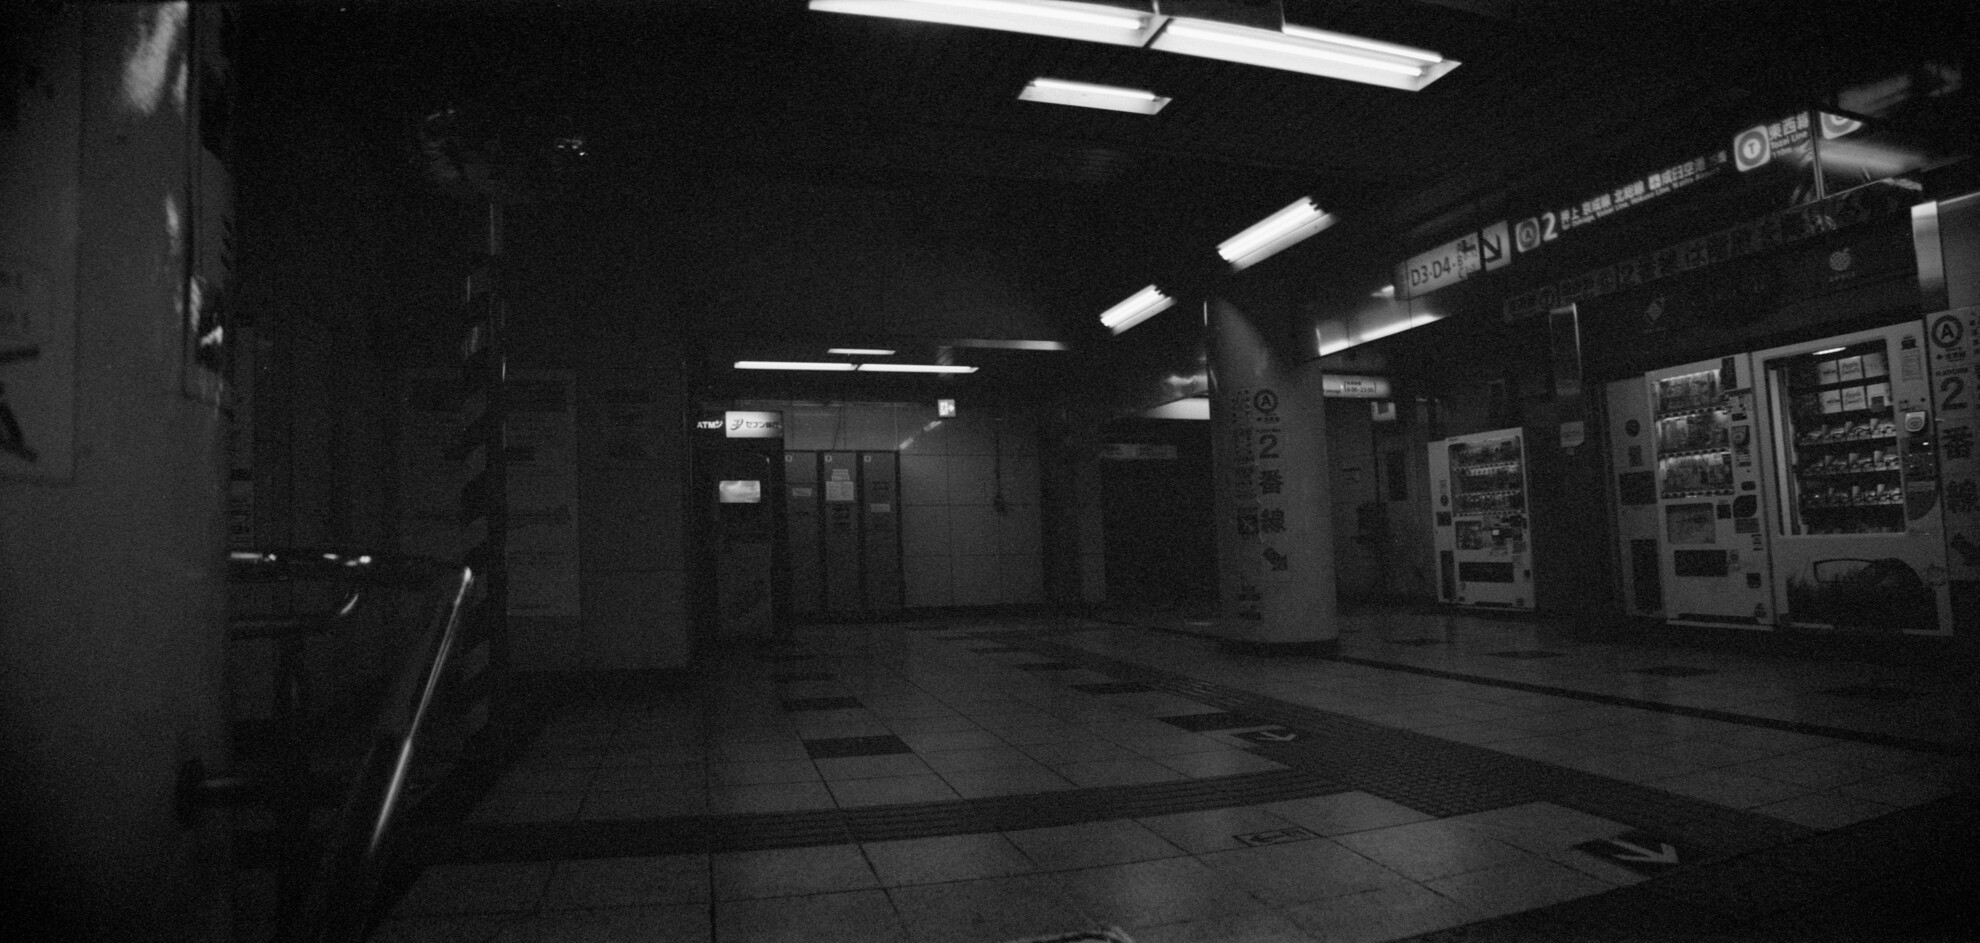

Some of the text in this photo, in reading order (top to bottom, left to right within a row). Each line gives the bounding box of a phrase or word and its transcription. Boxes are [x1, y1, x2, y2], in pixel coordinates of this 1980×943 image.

[1768, 112, 1809, 141] 東西線
[1540, 211, 1558, 242] 2
[1940, 323, 1954, 349] A
[1261, 395, 1271, 406] A
[1258, 433, 1286, 534] 2番線
